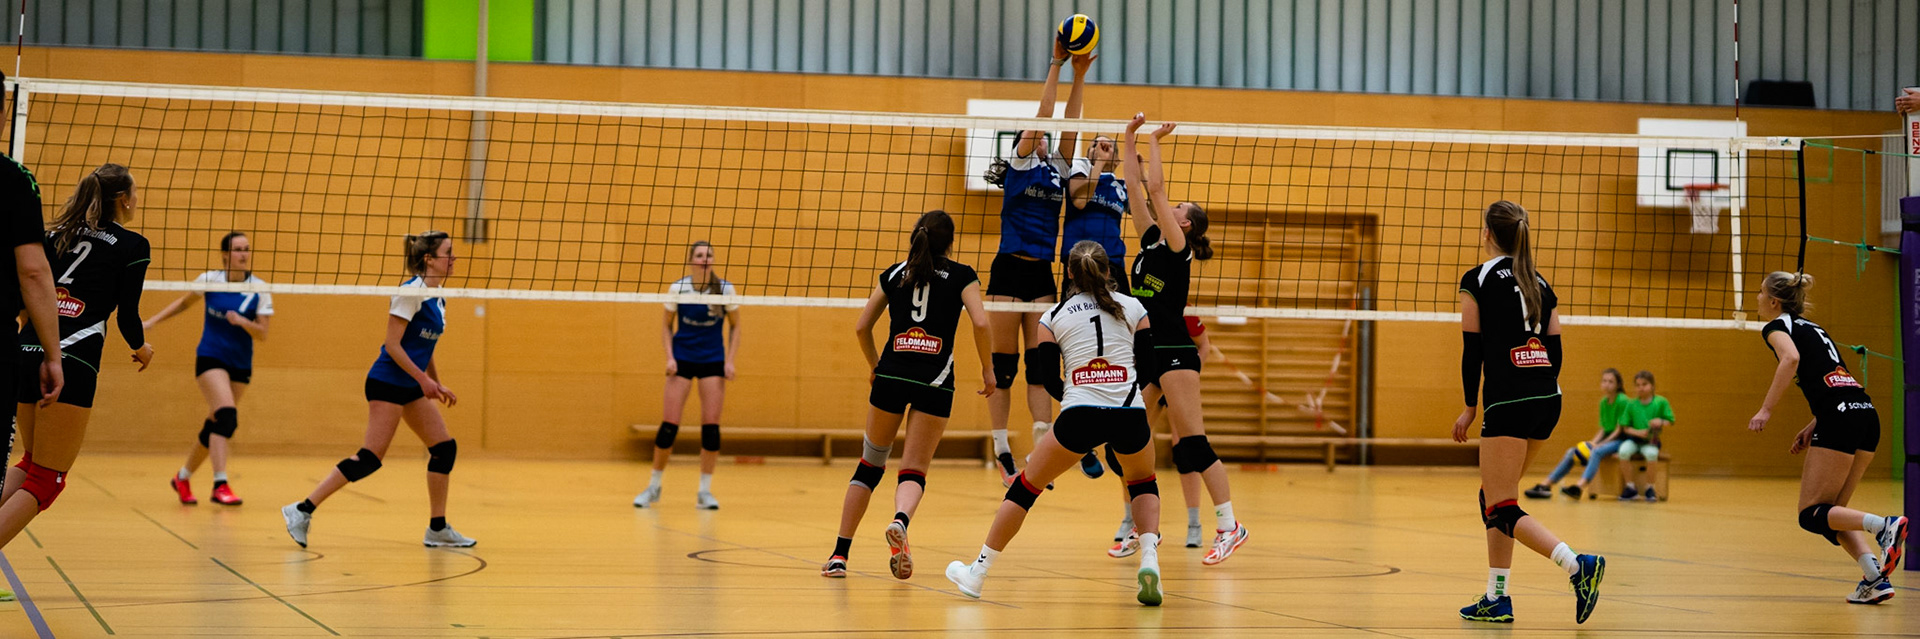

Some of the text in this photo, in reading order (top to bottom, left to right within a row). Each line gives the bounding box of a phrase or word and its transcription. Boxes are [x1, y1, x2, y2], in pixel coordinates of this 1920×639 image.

[1912, 122, 1920, 154] BENZ
[58, 241, 92, 284] 2
[56, 301, 80, 312] MANN
[911, 281, 931, 323] 9
[1067, 303, 1083, 315] SVK
[896, 337, 938, 348] FELDMANN
[1090, 315, 1103, 357] 1
[1813, 327, 1840, 364] 5
[1514, 350, 1549, 360] FELDMAN
[1075, 369, 1124, 381] FELDMANN
